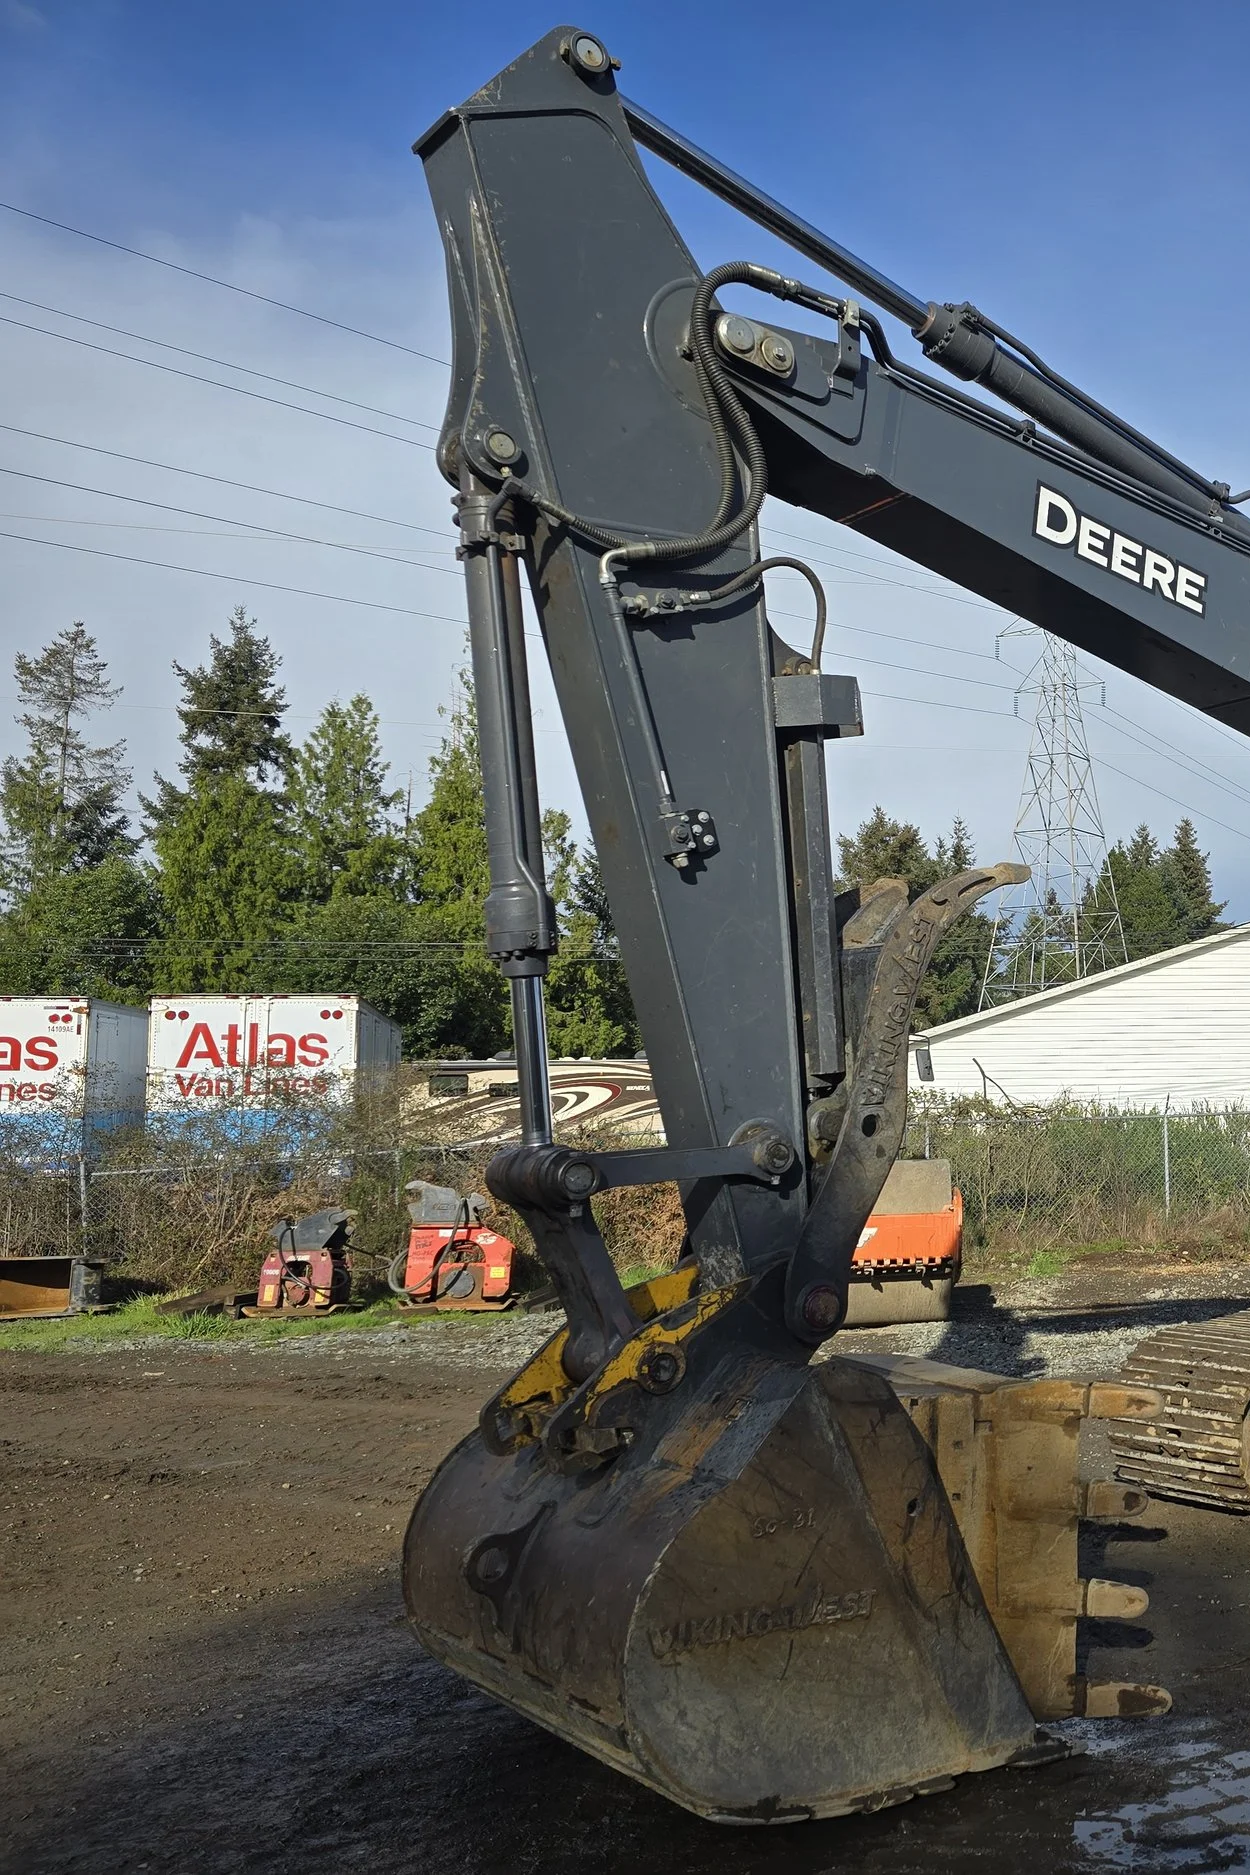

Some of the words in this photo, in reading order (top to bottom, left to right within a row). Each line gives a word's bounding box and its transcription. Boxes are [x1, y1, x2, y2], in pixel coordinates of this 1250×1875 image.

[1035, 485, 1206, 614] DEERE
[175, 1022, 329, 1068] Atlas
[175, 1073, 234, 1098] Van
